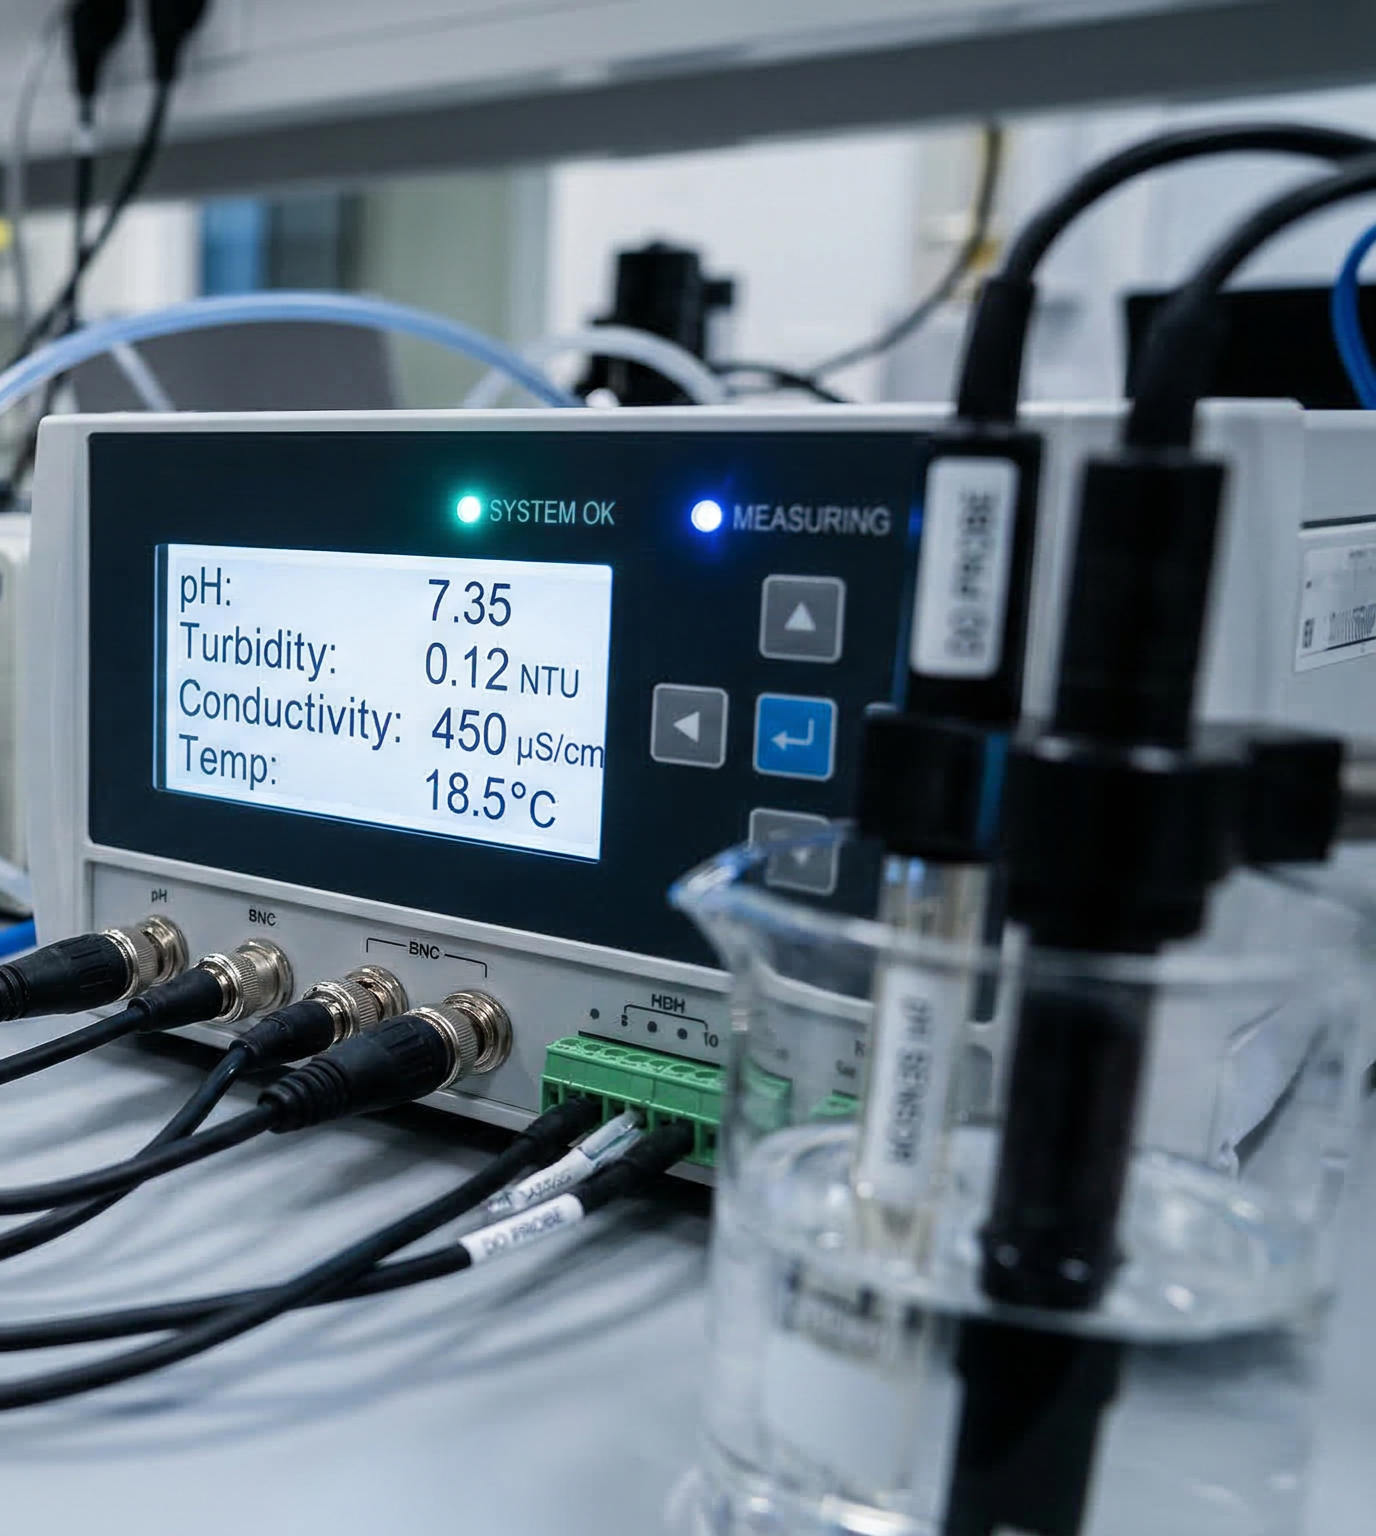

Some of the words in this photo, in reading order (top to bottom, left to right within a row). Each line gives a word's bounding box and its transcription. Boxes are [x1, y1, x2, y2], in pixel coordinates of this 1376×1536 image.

[489, 500, 576, 524] SYSTEM
[582, 501, 616, 526] OK
[733, 503, 892, 537] MEASURING
[180, 566, 231, 613] pH:
[428, 579, 512, 627] 7.35
[180, 621, 336, 682] Turbidity:
[425, 642, 509, 691] 0.12
[520, 663, 580, 699] NTU
[179, 678, 401, 751] Conductivity:
[431, 707, 507, 756] 450
[517, 732, 604, 769] µS/cm
[179, 733, 277, 791] Temp:
[426, 768, 557, 829] 18.5°C
[150, 888, 168, 903] pH
[248, 907, 277, 927] BNC
[408, 940, 440, 960] BNC
